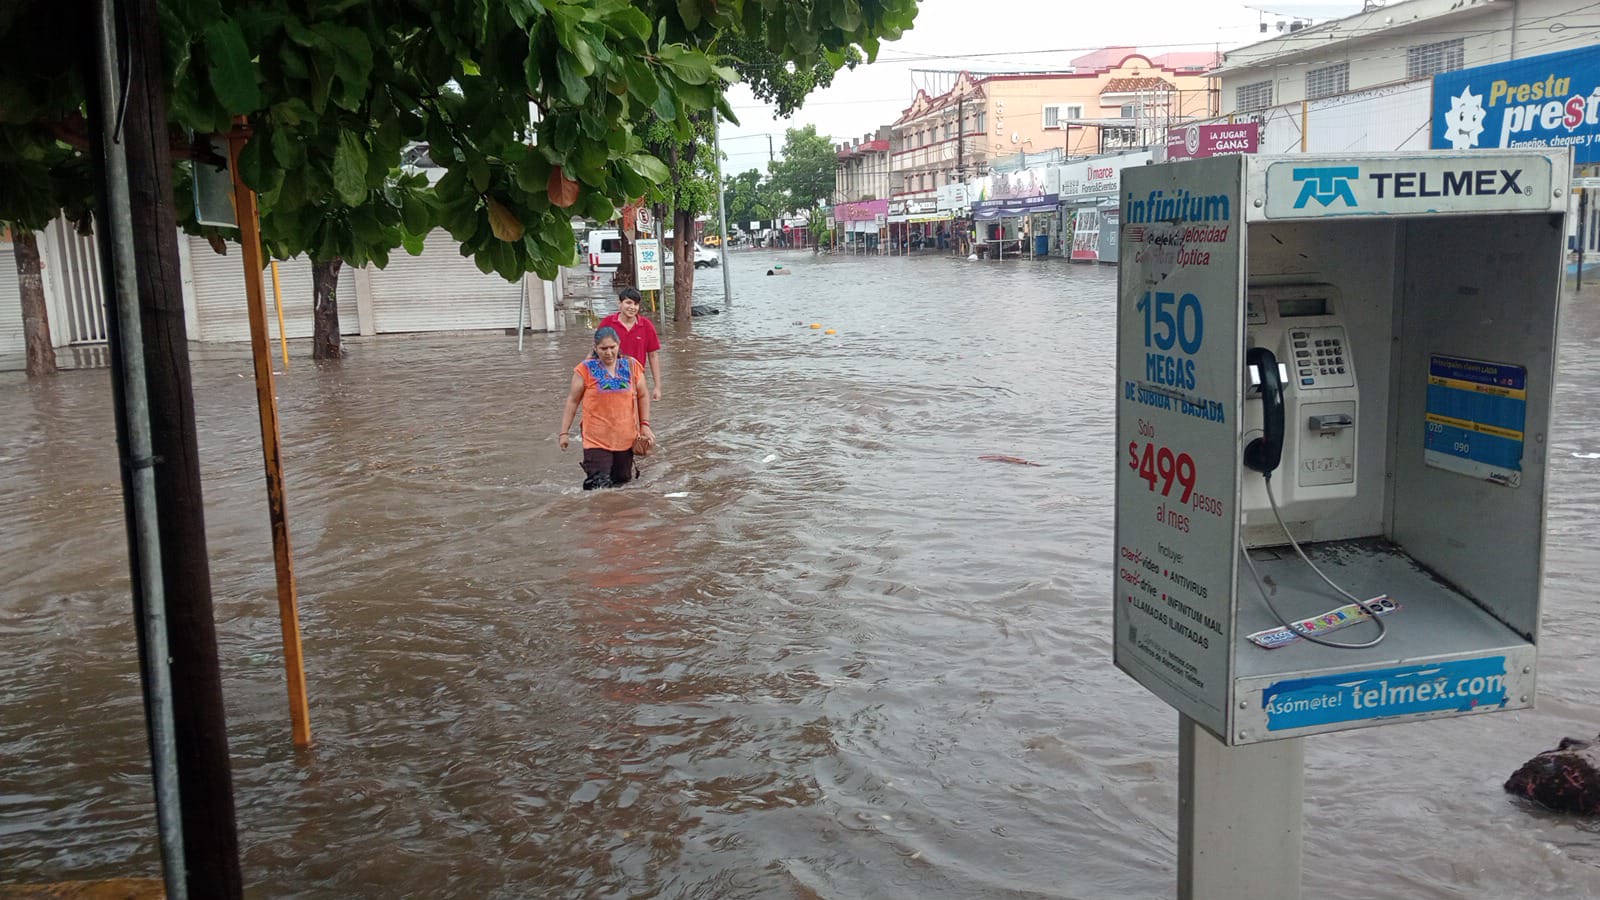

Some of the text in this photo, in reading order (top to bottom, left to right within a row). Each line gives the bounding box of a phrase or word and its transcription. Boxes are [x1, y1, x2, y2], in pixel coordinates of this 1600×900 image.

[1489, 74, 1571, 107] Presta
[1219, 130, 1247, 140] JUGAR!
[1550, 133, 1585, 148] cheques
[1585, 132, 1594, 146] y
[1369, 169, 1523, 199] TELMEX
[1127, 189, 1229, 223] infinitum
[1136, 291, 1204, 355] 150
[1146, 352, 1196, 391] MEGAS
[1125, 381, 1136, 401] DE
[1138, 388, 1171, 411] SUBIDA
[1181, 396, 1225, 424] BAJADA
[1138, 418, 1155, 439] Solo
[1128, 440, 1223, 517] $499 pesos
[1156, 502, 1190, 534] al mes
[1170, 571, 1207, 598] ANTIVIRUS
[1133, 596, 1168, 626] LLAMADAS
[1168, 617, 1209, 649] ILIMITADAS
[1167, 596, 1203, 624] INFINITUM
[1203, 615, 1224, 636] MAIL
[1265, 690, 1343, 716] Asóm@te!
